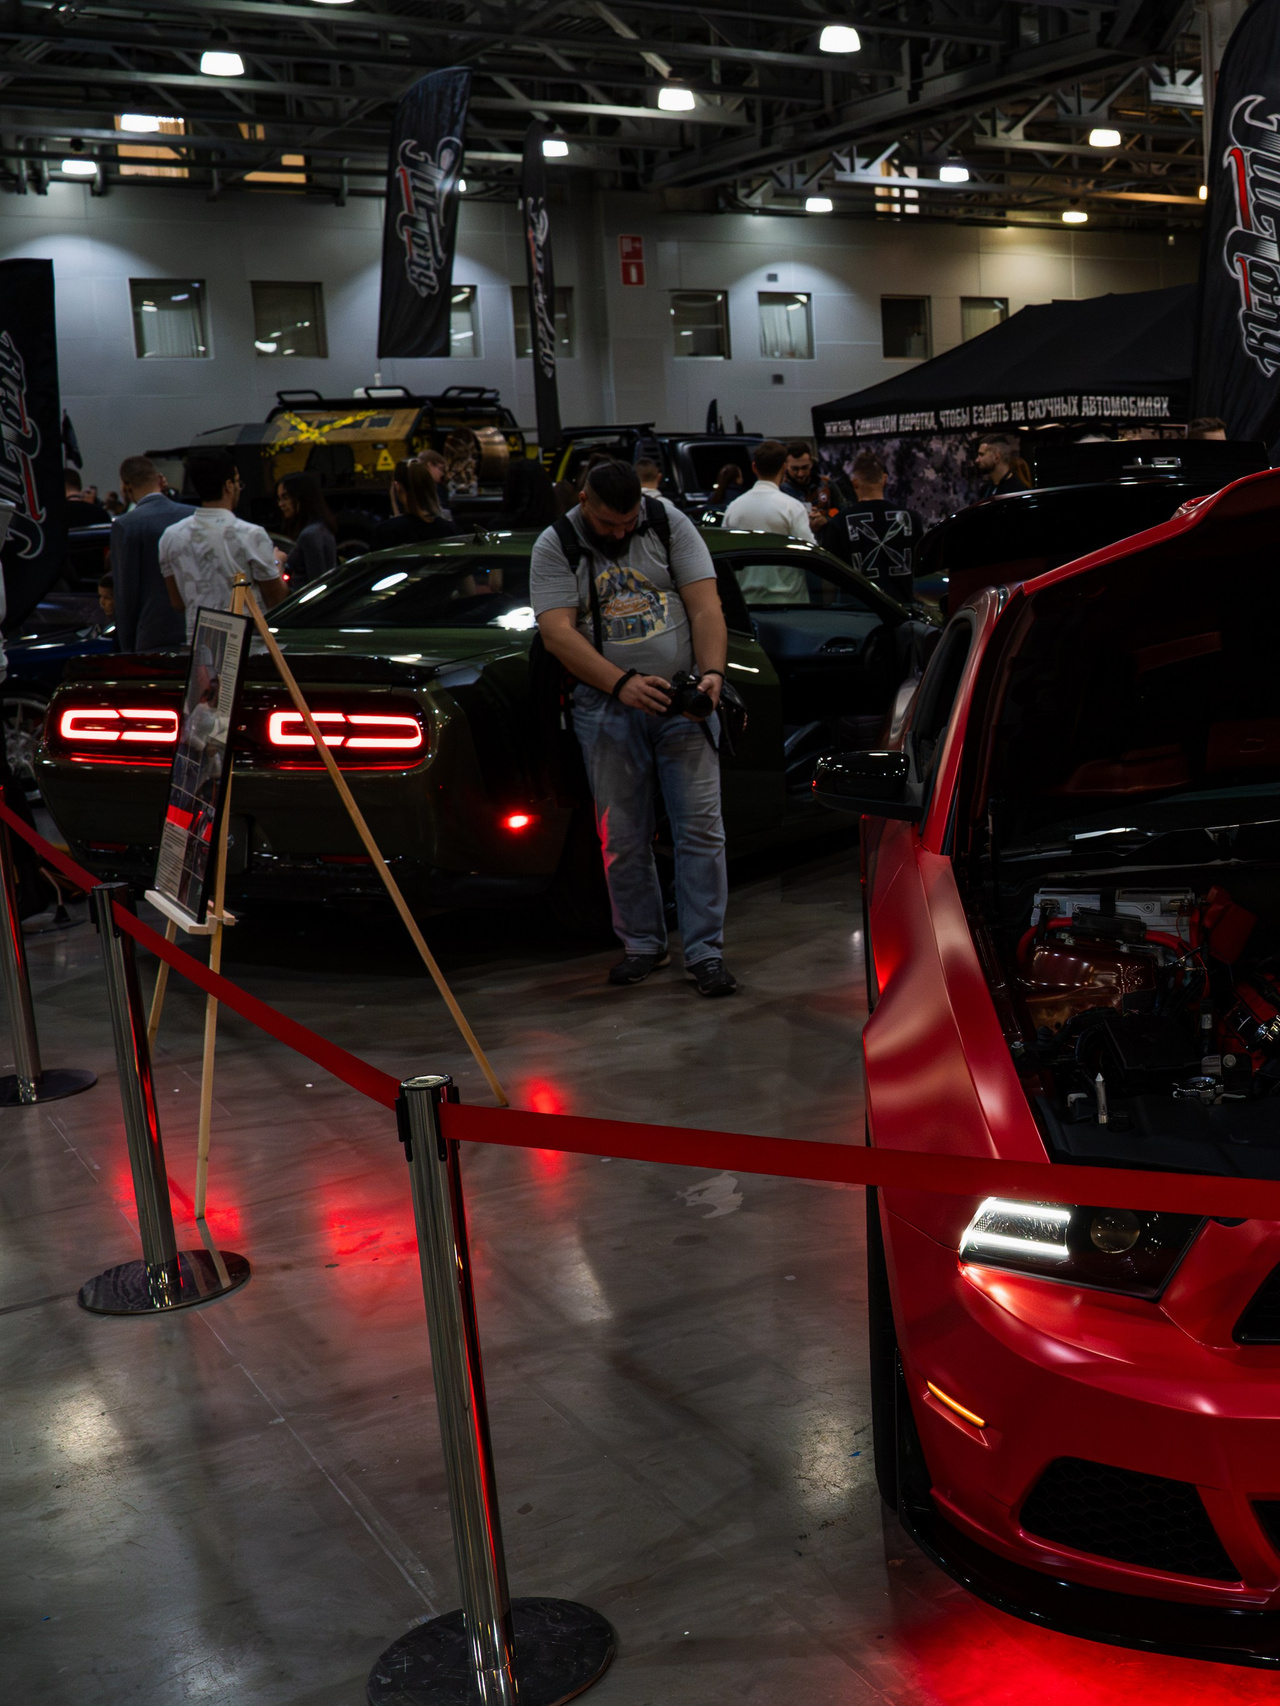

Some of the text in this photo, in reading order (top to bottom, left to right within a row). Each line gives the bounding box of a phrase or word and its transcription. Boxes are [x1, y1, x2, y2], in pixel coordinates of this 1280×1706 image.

[939, 406, 970, 428] ЧТОБЫ
[972, 402, 1010, 428] ЕЗДИТЬ
[1011, 401, 1026, 421] НА
[1027, 396, 1079, 420] СКУЧНЫХ
[1081, 395, 1170, 418] АВТОМОБИЛЯХ
